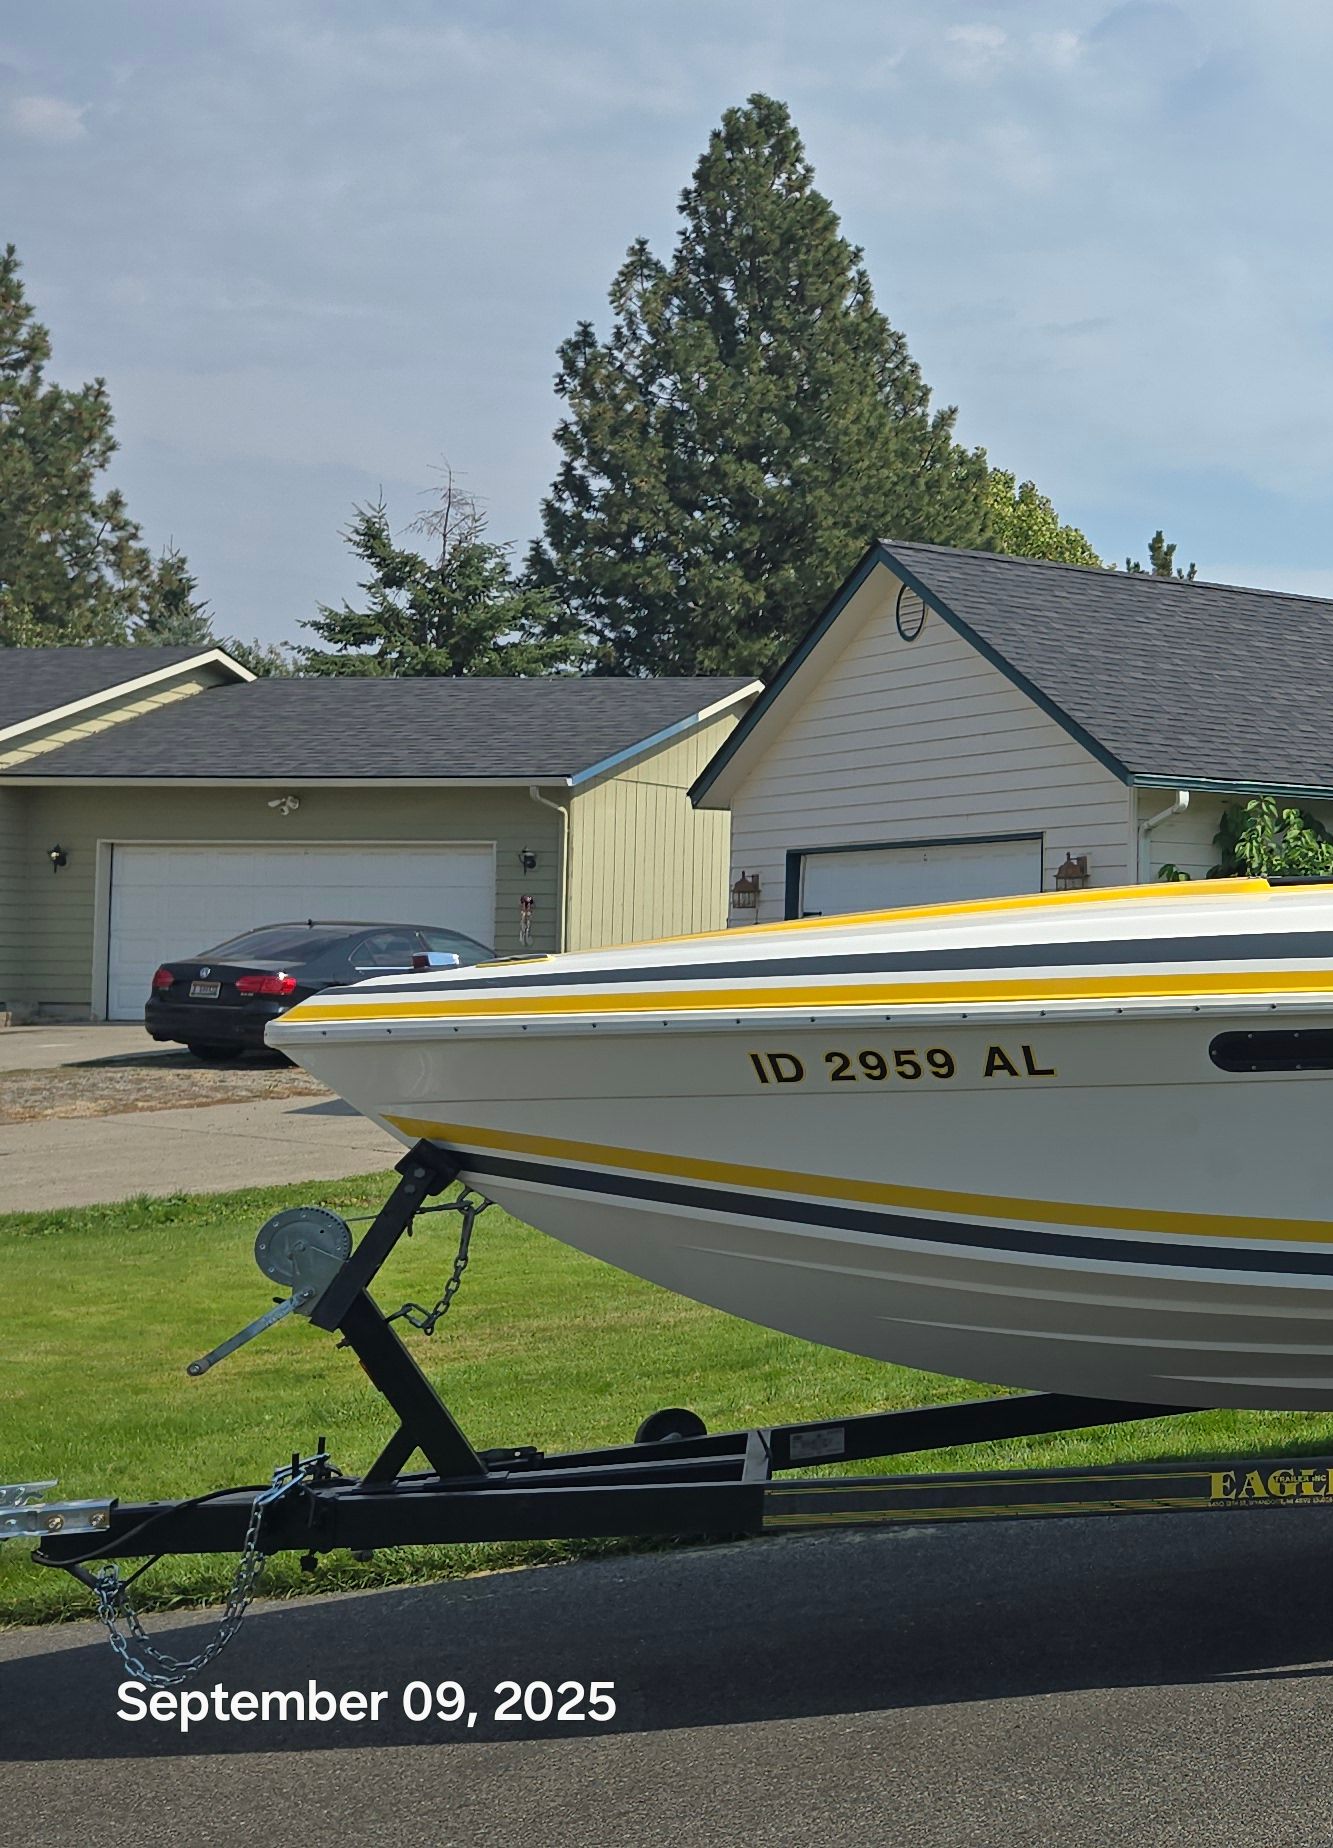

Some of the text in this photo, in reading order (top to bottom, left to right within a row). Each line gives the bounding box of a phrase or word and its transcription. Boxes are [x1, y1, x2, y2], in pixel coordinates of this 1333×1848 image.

[749, 1044, 1057, 1084] ID 2959 AL
